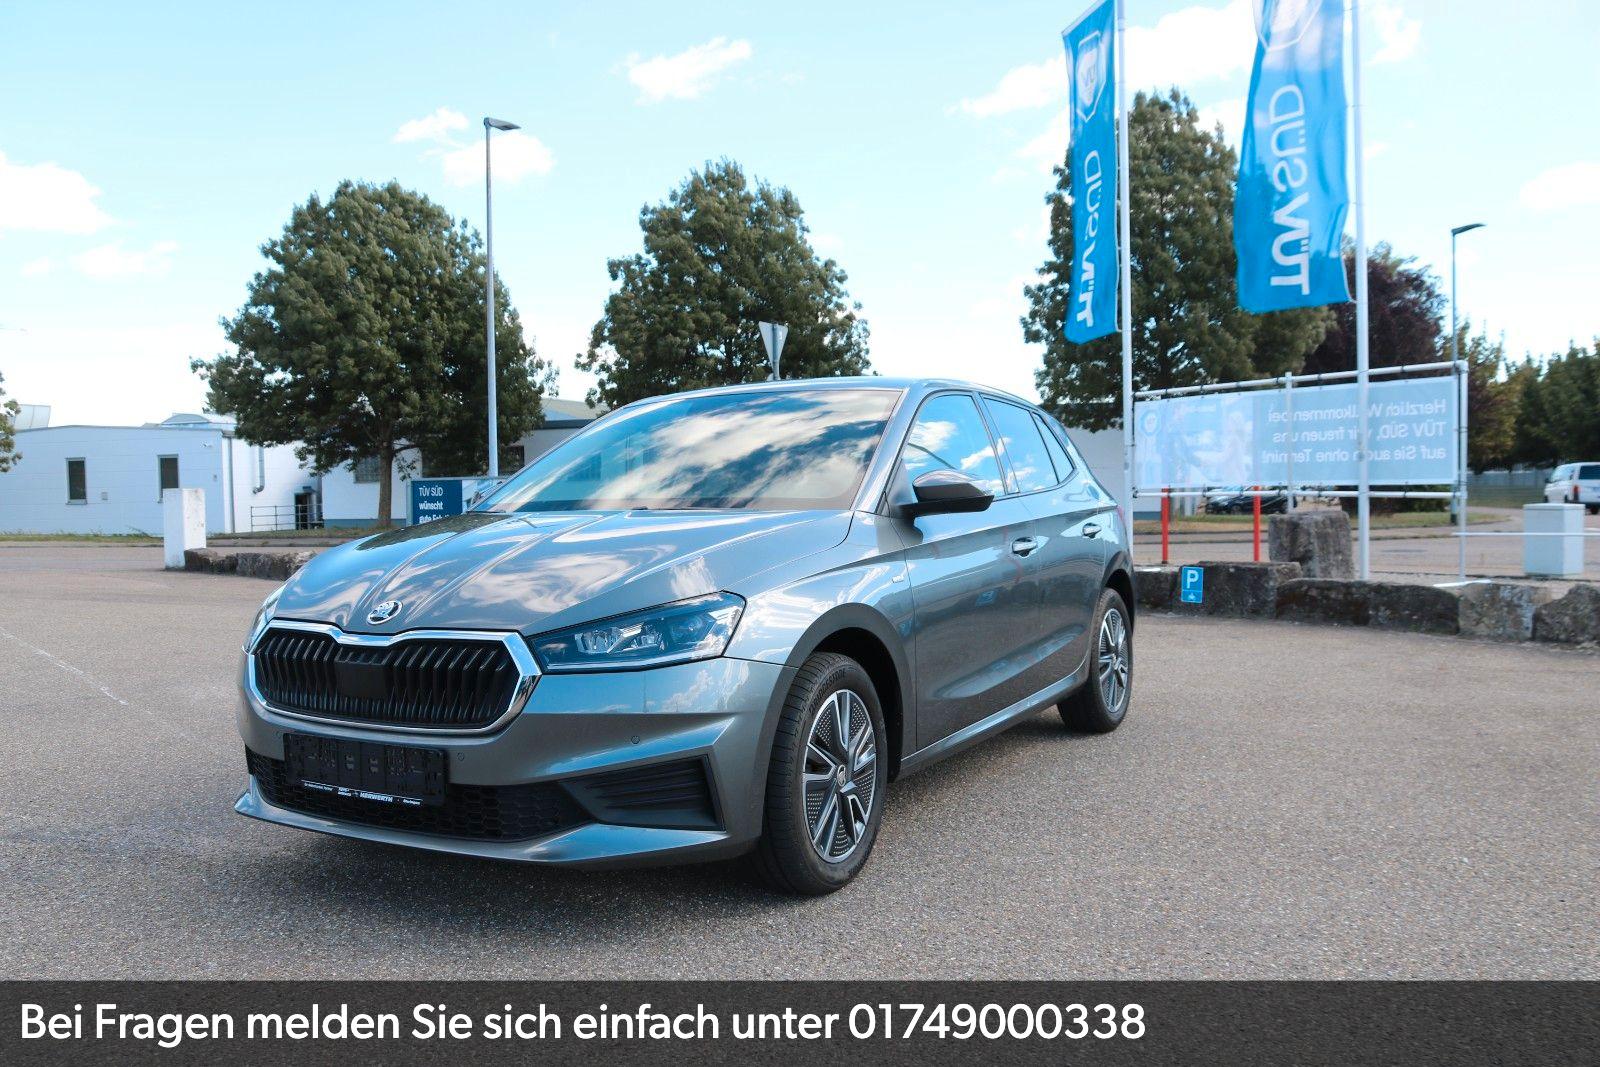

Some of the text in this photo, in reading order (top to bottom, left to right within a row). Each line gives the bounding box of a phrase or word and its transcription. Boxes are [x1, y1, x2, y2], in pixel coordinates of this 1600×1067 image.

[418, 485, 444, 496] TÜV SÜD
[418, 500, 444, 510] wünscht
[1186, 569, 1199, 588] P
